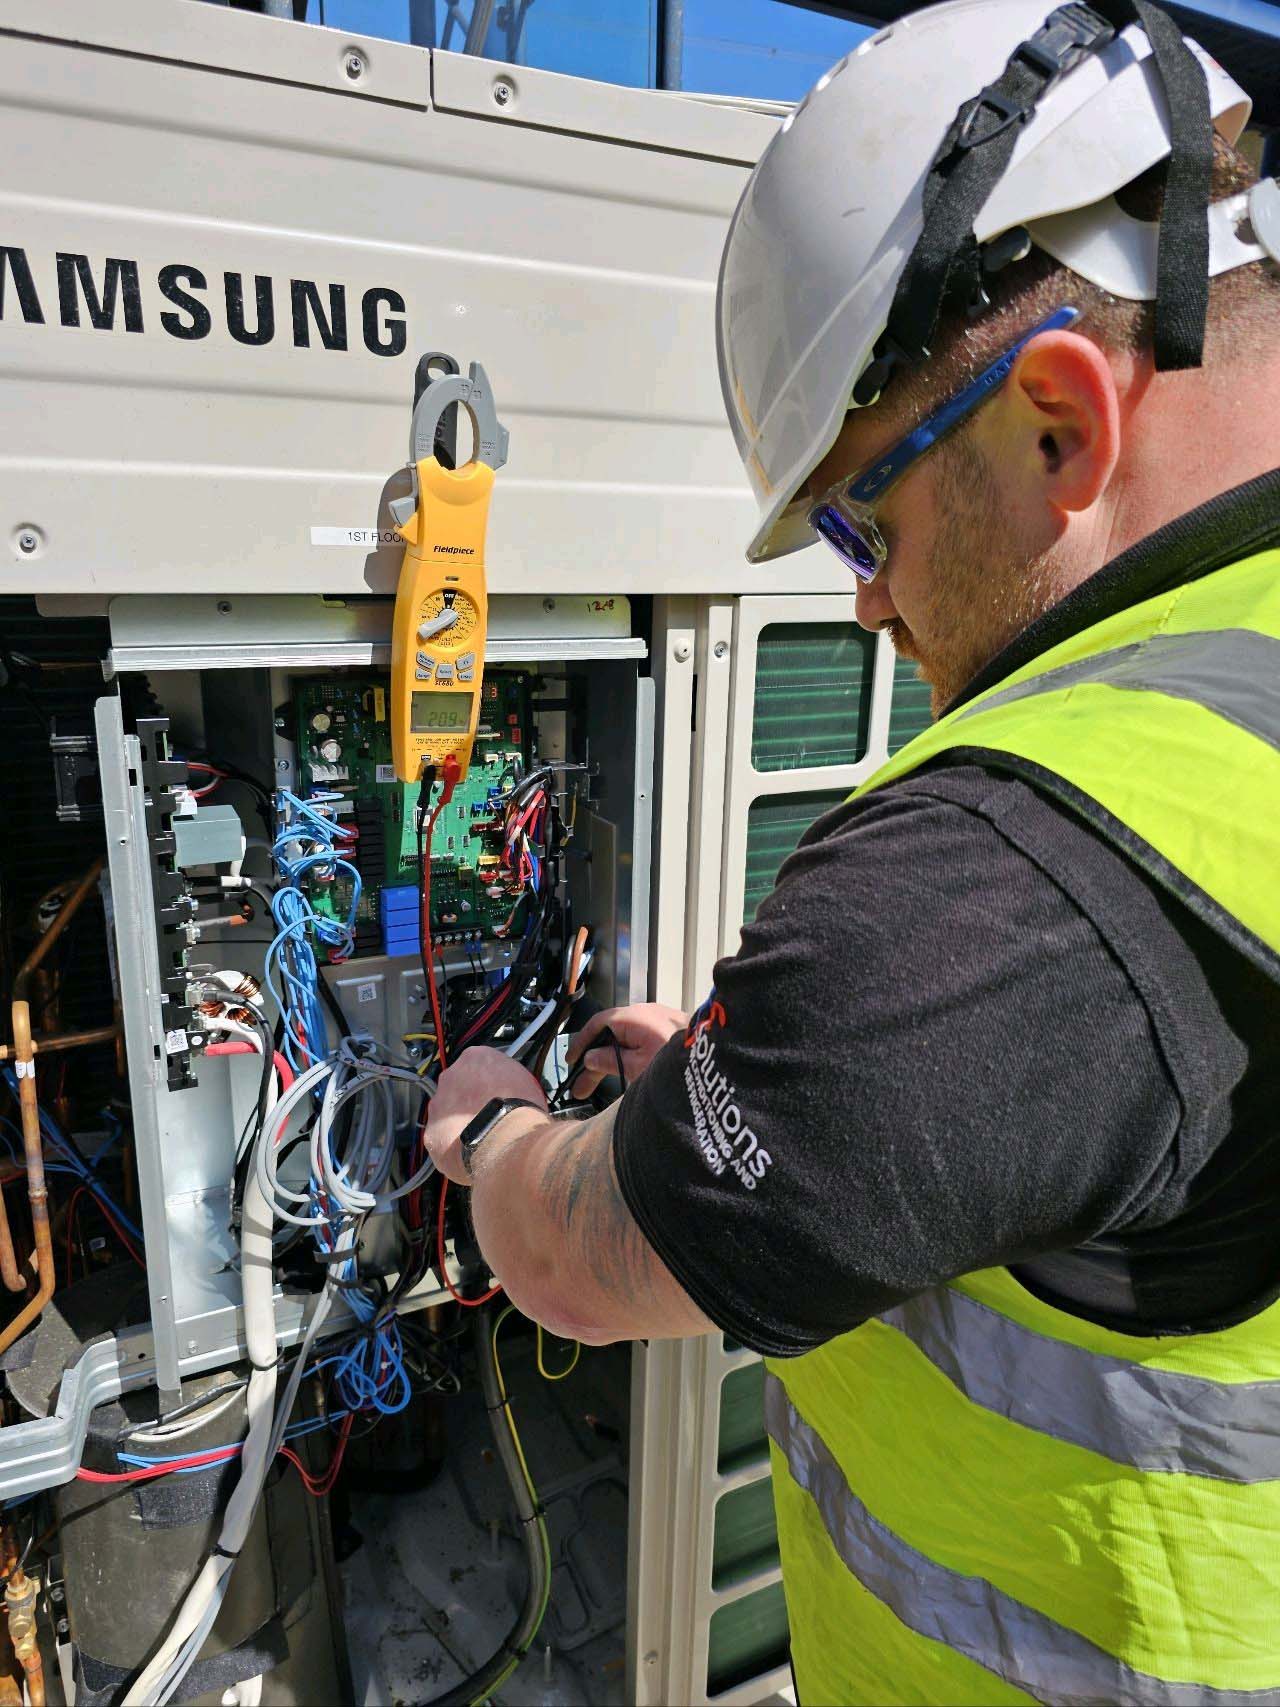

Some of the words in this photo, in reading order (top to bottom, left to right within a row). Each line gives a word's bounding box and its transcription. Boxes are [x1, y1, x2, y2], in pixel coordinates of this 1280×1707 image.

[347, 531, 368, 542] 1ST
[371, 532, 404, 543] FLOO
[433, 545, 475, 555] Fieldpiece
[683, 1065, 727, 1176] REFRIGERATION
[729, 1158, 758, 1190] AND
